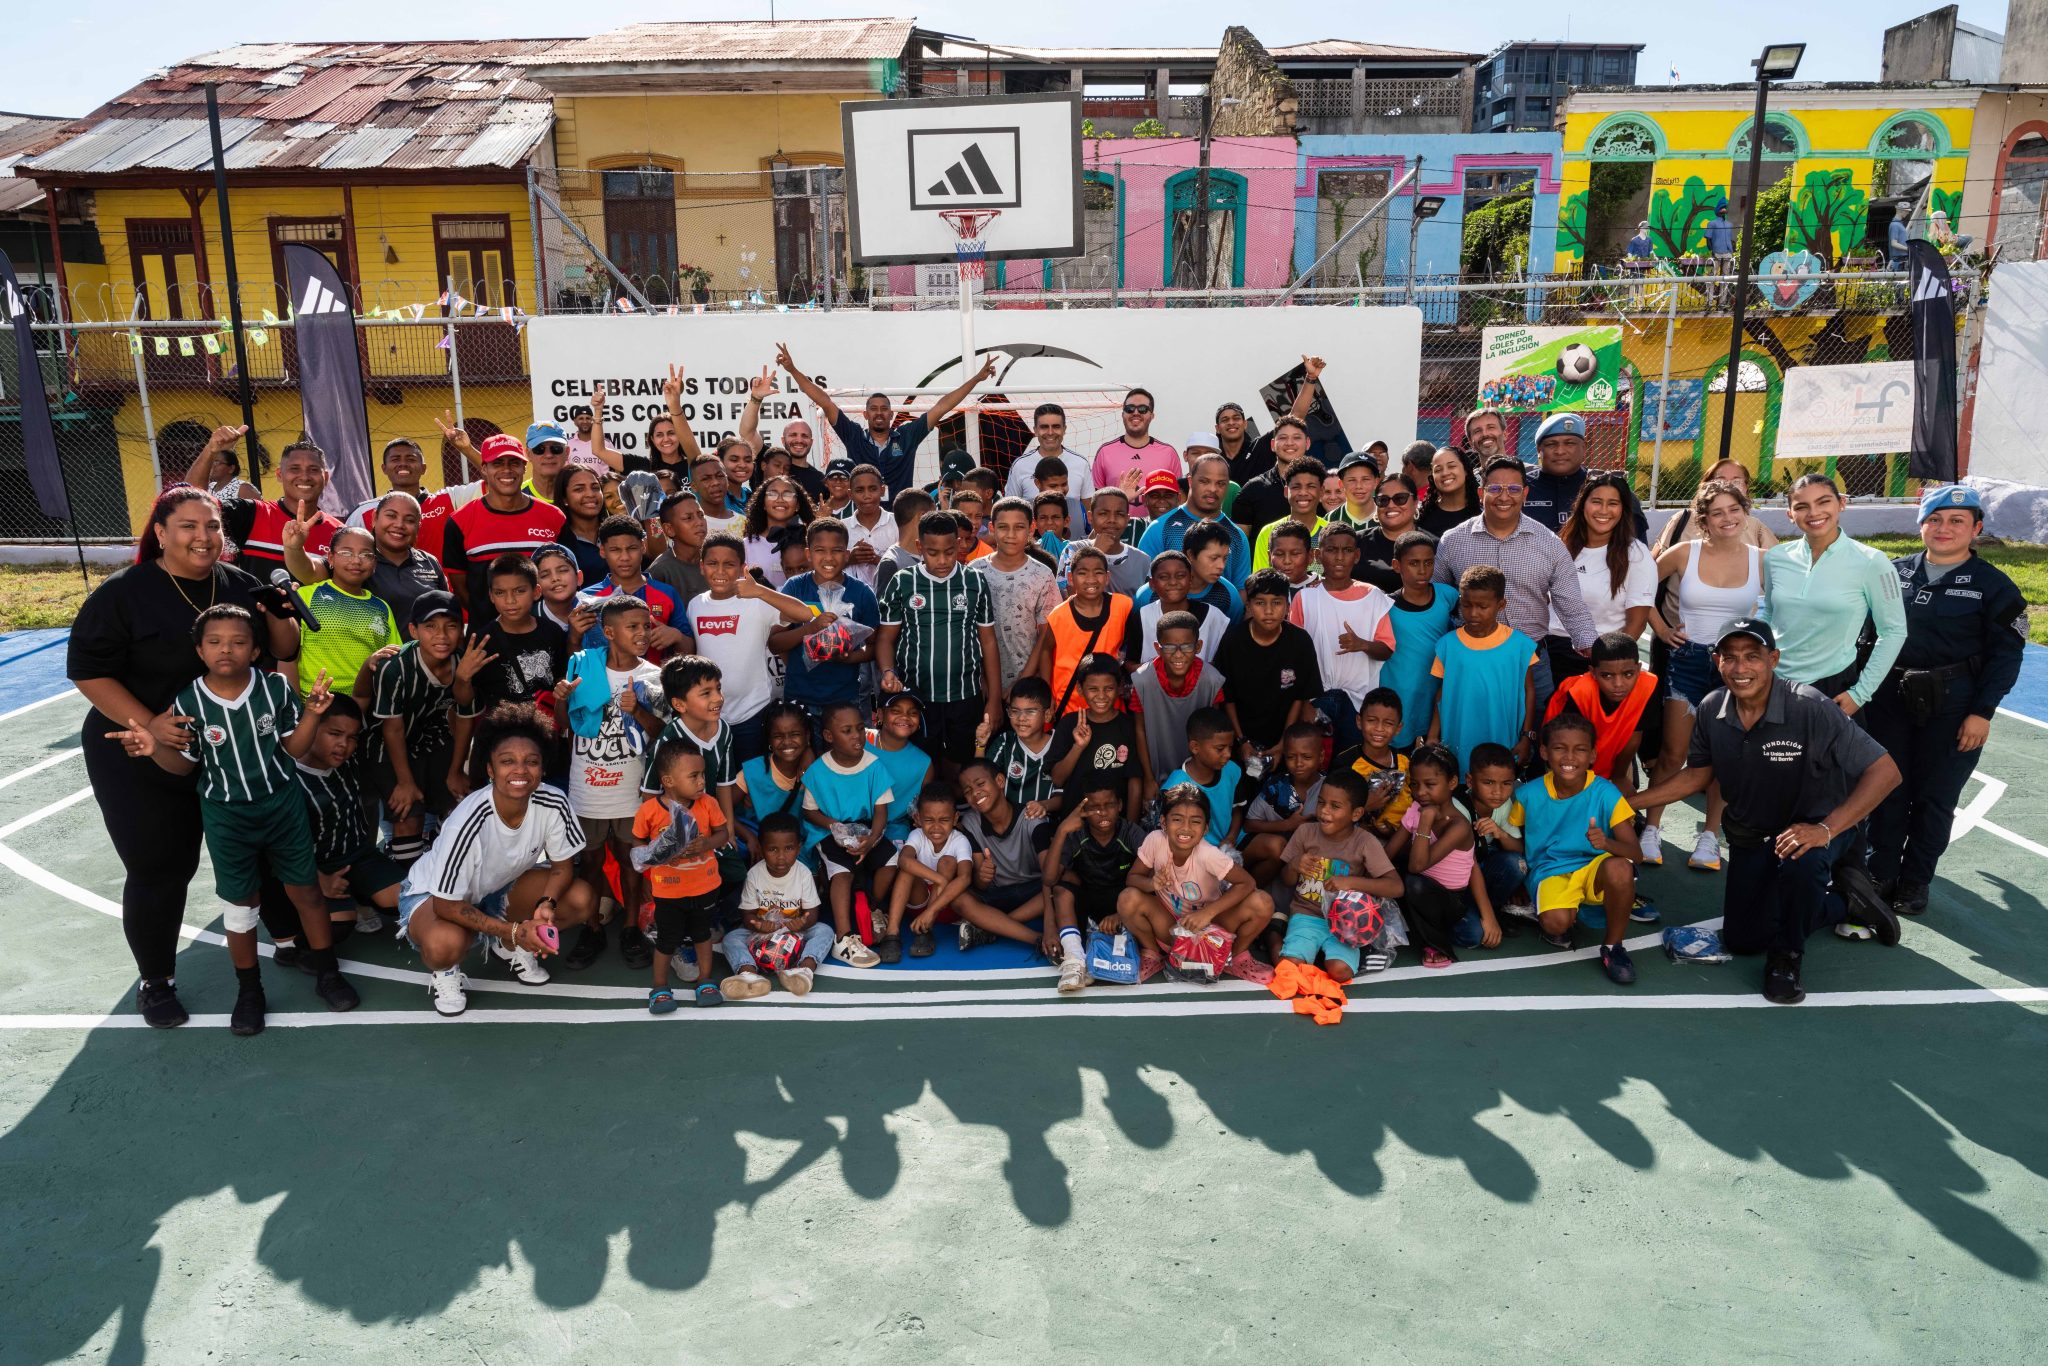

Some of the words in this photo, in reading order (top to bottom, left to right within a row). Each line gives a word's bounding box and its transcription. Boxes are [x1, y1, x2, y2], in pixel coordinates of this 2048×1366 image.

[1494, 329, 1526, 342] TORNEO
[1489, 339, 1515, 351] GOLES
[1516, 335, 1534, 345] POR
[1485, 351, 1496, 360] LA
[551, 377, 699, 397] CELEBRAMS
[705, 376, 779, 395] TODS
[786, 375, 828, 393] LS
[631, 403, 696, 421] COO
[703, 402, 723, 420] SI
[730, 402, 803, 420] FERA
[1149, 475, 1174, 485] adidas
[527, 527, 546, 537] FCC
[1762, 740, 1803, 750] FUNDACIÓN
[594, 767, 624, 778] Pizza
